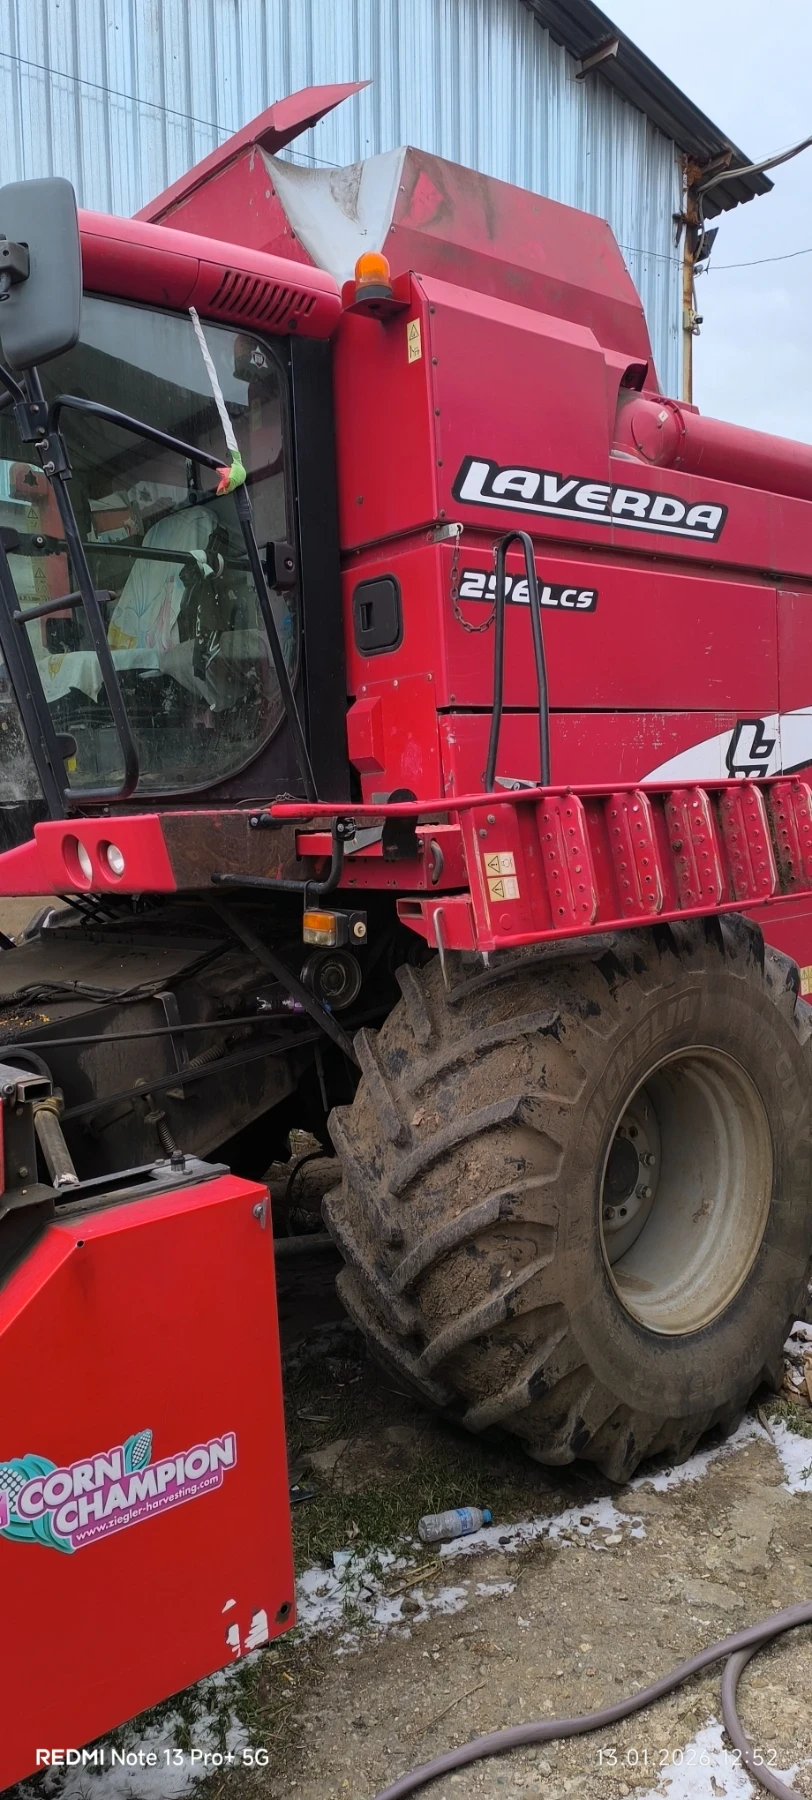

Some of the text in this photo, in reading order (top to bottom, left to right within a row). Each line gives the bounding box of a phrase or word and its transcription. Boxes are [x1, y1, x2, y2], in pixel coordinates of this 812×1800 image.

[460, 461, 723, 530] LAVERDA
[20, 1450, 122, 1514] CORN
[55, 1436, 234, 1534] CHAMPION
[76, 1475, 219, 1541] www.ziegler-harvesting.com
